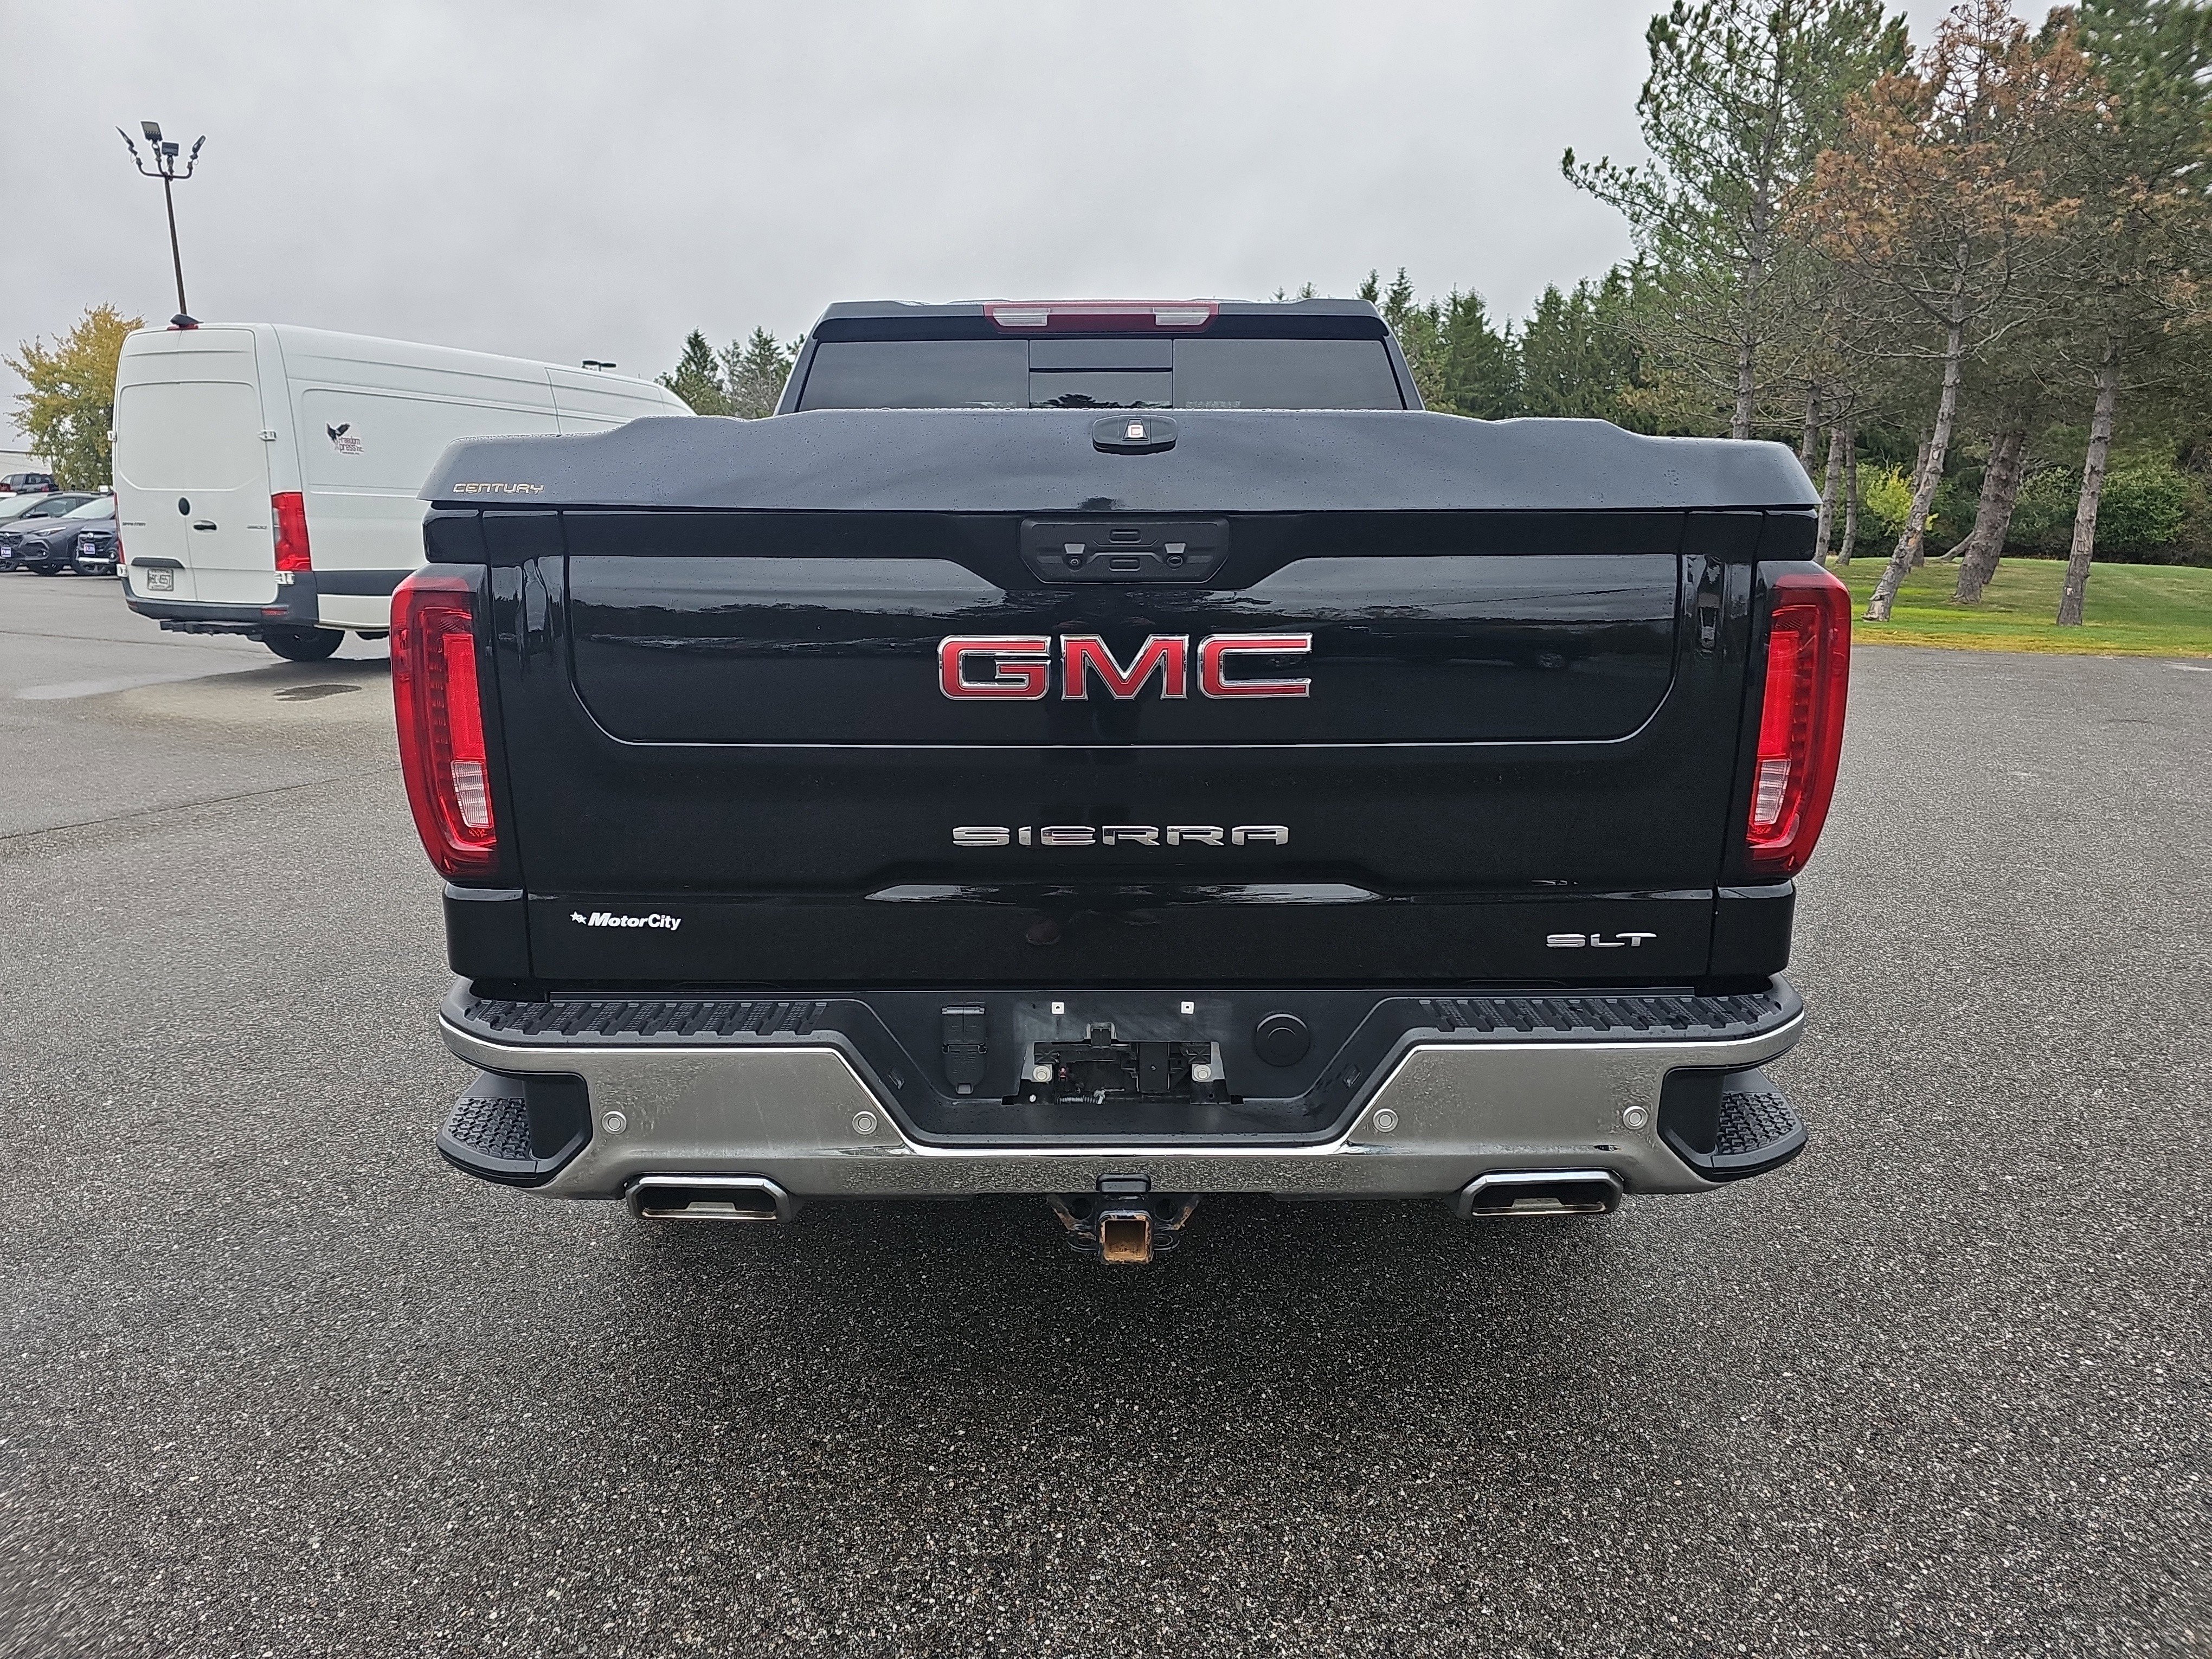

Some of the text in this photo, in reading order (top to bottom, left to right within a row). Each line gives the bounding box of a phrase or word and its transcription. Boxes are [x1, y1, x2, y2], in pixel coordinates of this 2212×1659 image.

[453, 483, 544, 494] CENTURY
[938, 633, 1312, 700] GMC
[953, 826, 1289, 846] SIERRA
[588, 912, 681, 930] MotorCity
[1546, 933, 1657, 947] SLT
